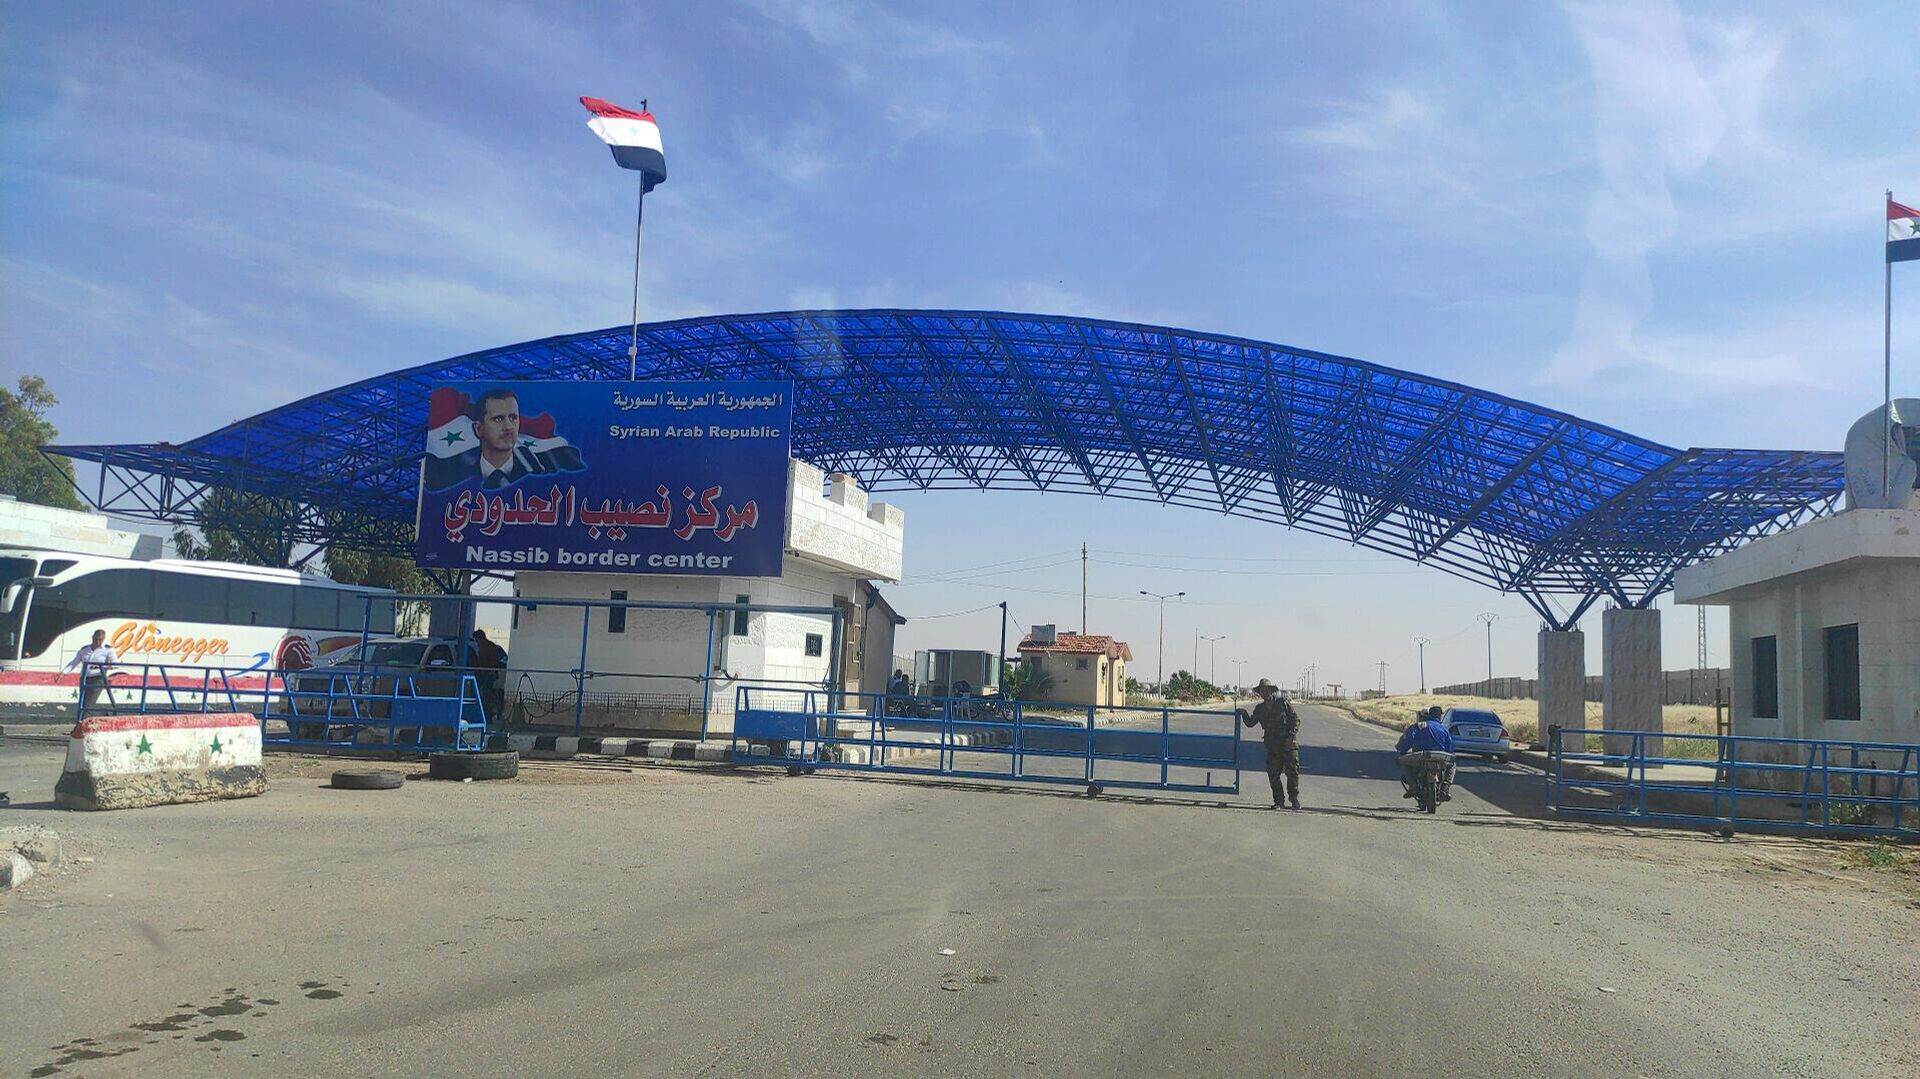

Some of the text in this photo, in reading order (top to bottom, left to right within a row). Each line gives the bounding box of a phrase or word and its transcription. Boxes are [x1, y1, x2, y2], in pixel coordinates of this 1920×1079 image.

[613, 390, 783, 412] الجمهورية العربية السورية
[609, 425, 781, 440] Syrian Arab Republic
[444, 484, 760, 543] مركز نصيب الحدودي
[466, 545, 733, 569] Nassib border center
